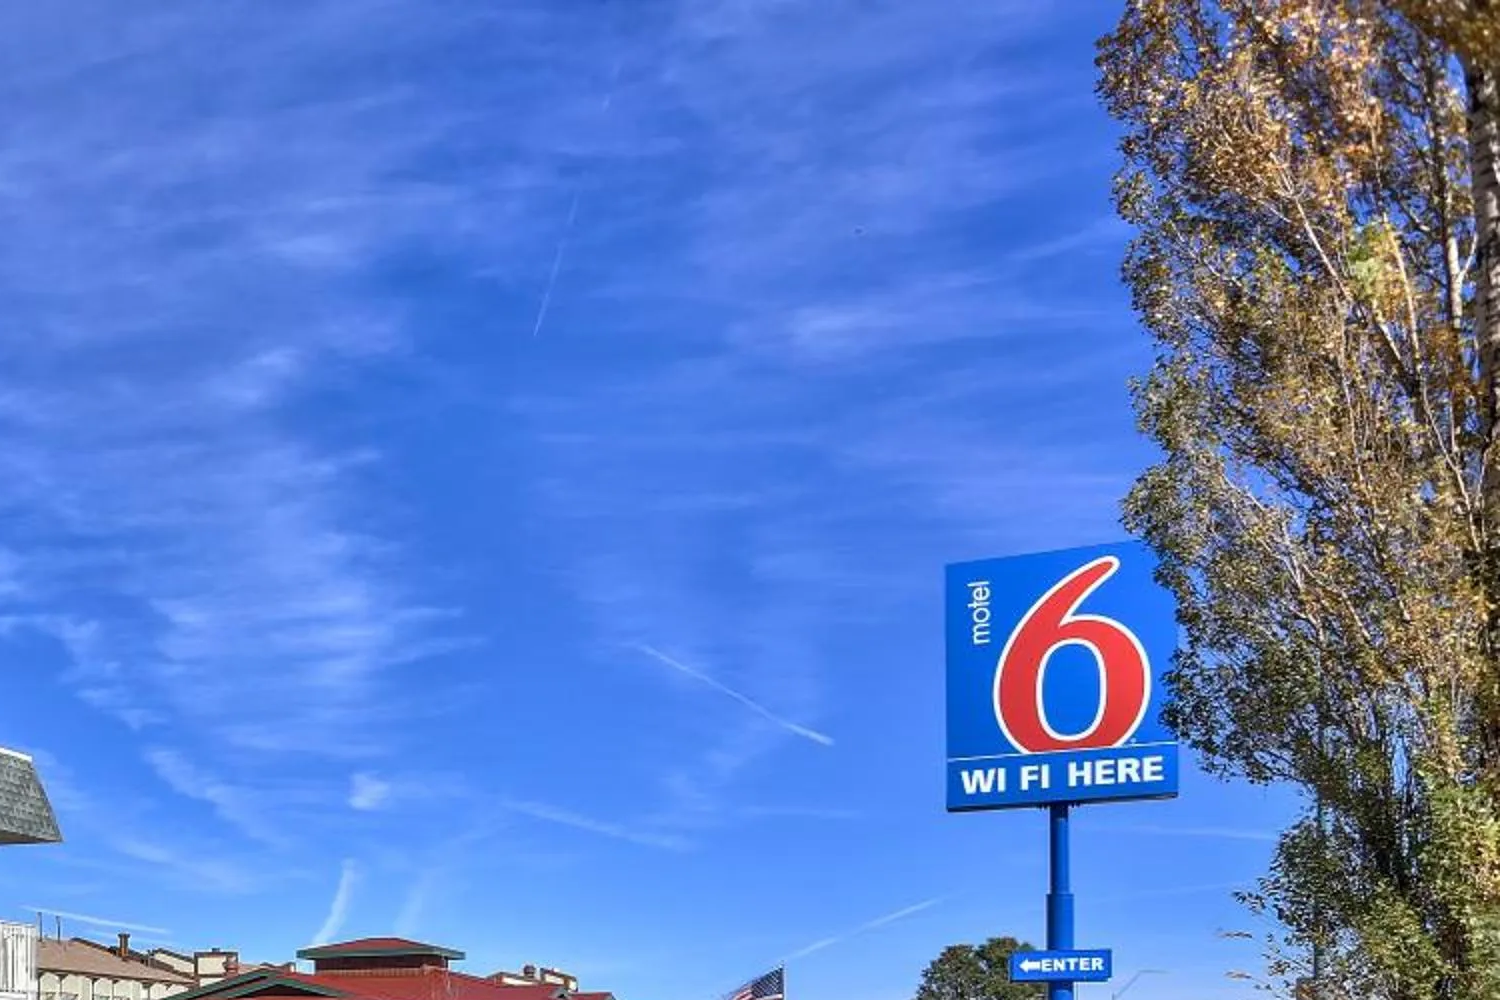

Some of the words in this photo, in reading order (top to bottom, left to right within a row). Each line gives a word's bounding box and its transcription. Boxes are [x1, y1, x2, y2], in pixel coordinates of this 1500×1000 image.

[967, 580, 990, 645] motel
[993, 555, 1150, 755] 6
[961, 767, 1006, 795] WI
[1020, 763, 1049, 790] FI
[1068, 755, 1164, 787] HERE
[1041, 957, 1104, 972] ENTER
